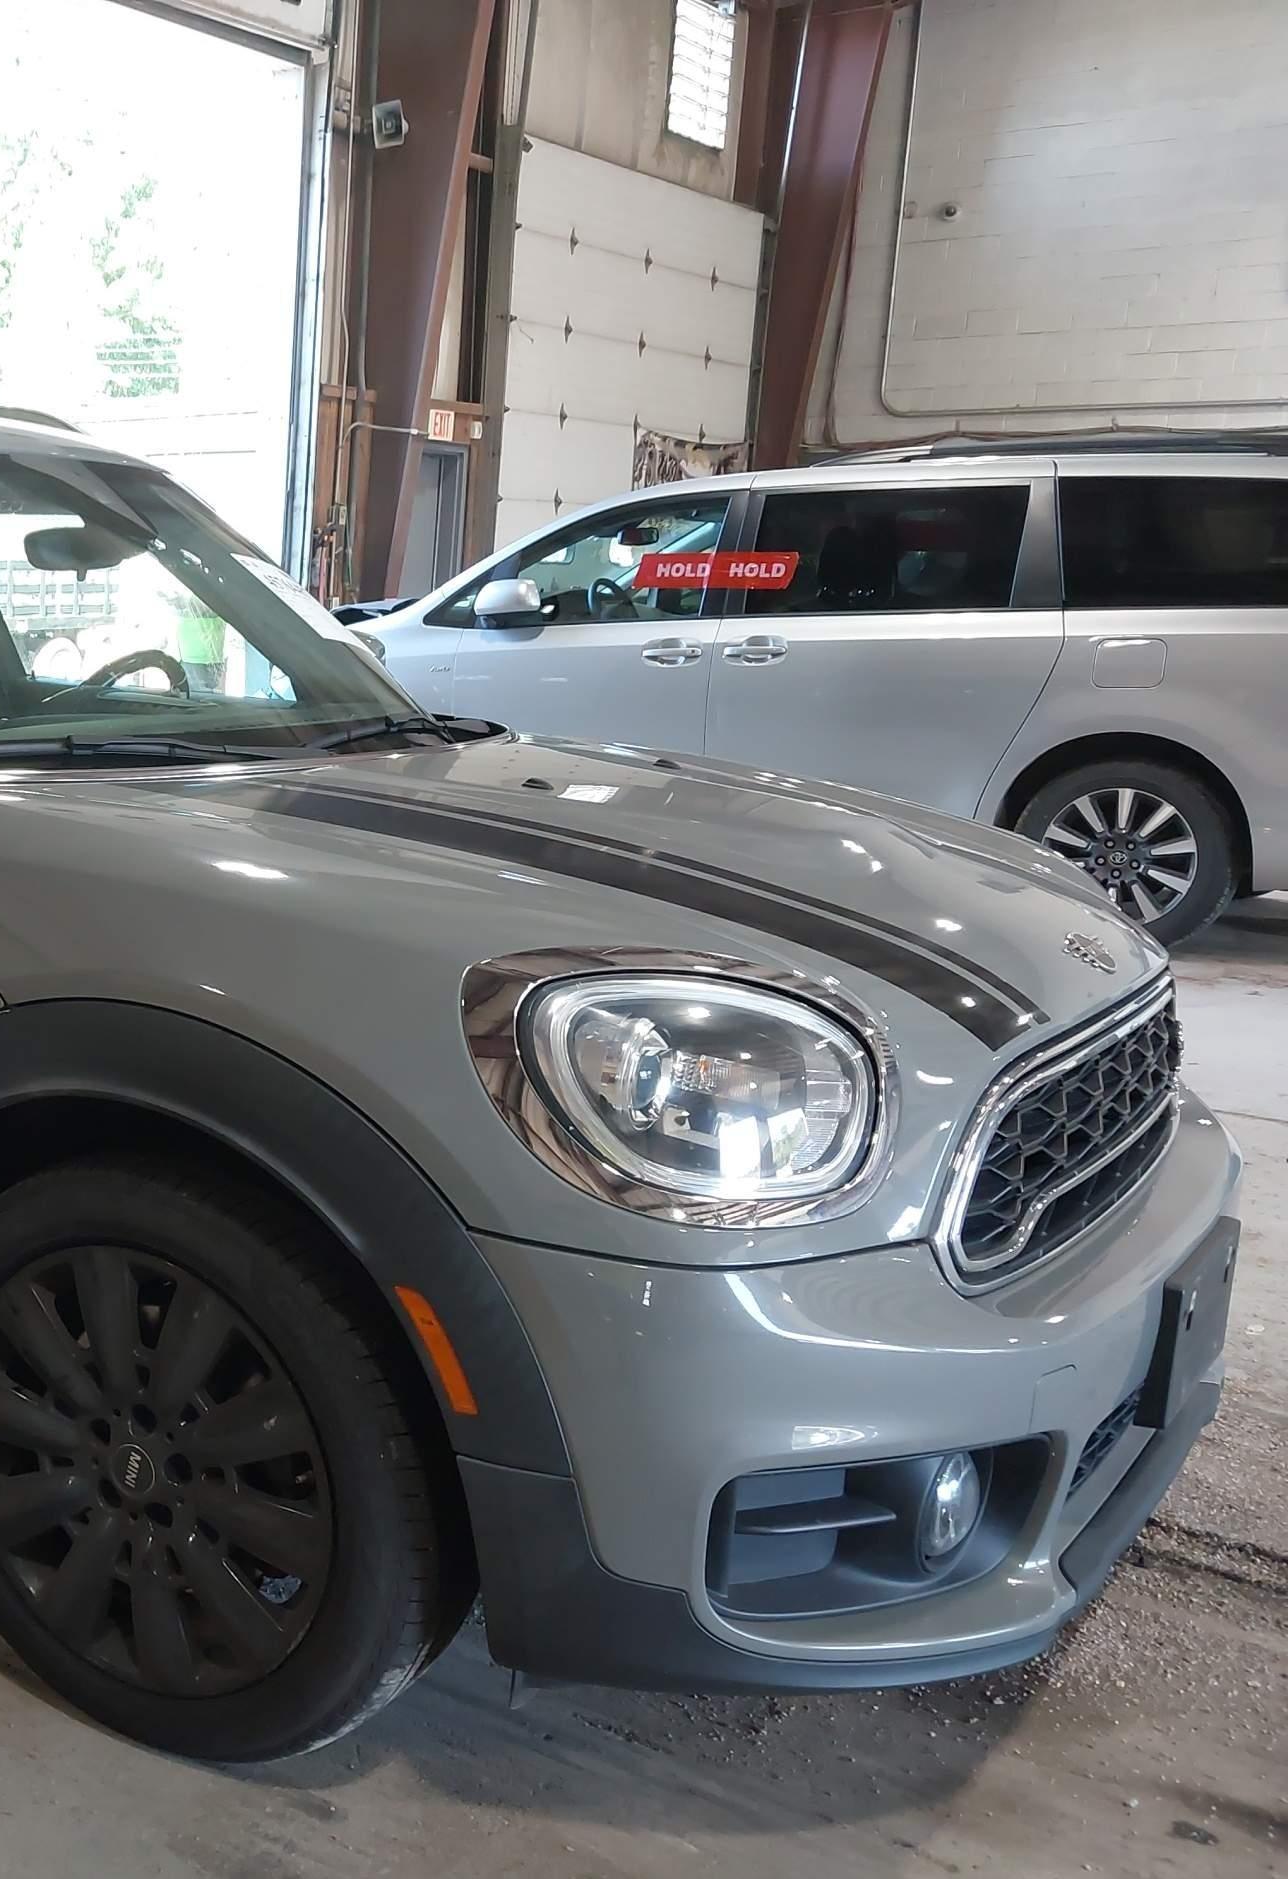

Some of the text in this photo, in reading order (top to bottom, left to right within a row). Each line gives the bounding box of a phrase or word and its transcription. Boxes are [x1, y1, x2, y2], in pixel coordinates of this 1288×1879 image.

[433, 411, 451, 438] EXIT
[656, 562, 786, 578] HOLD HOLD
[124, 1451, 142, 1489] MINI
